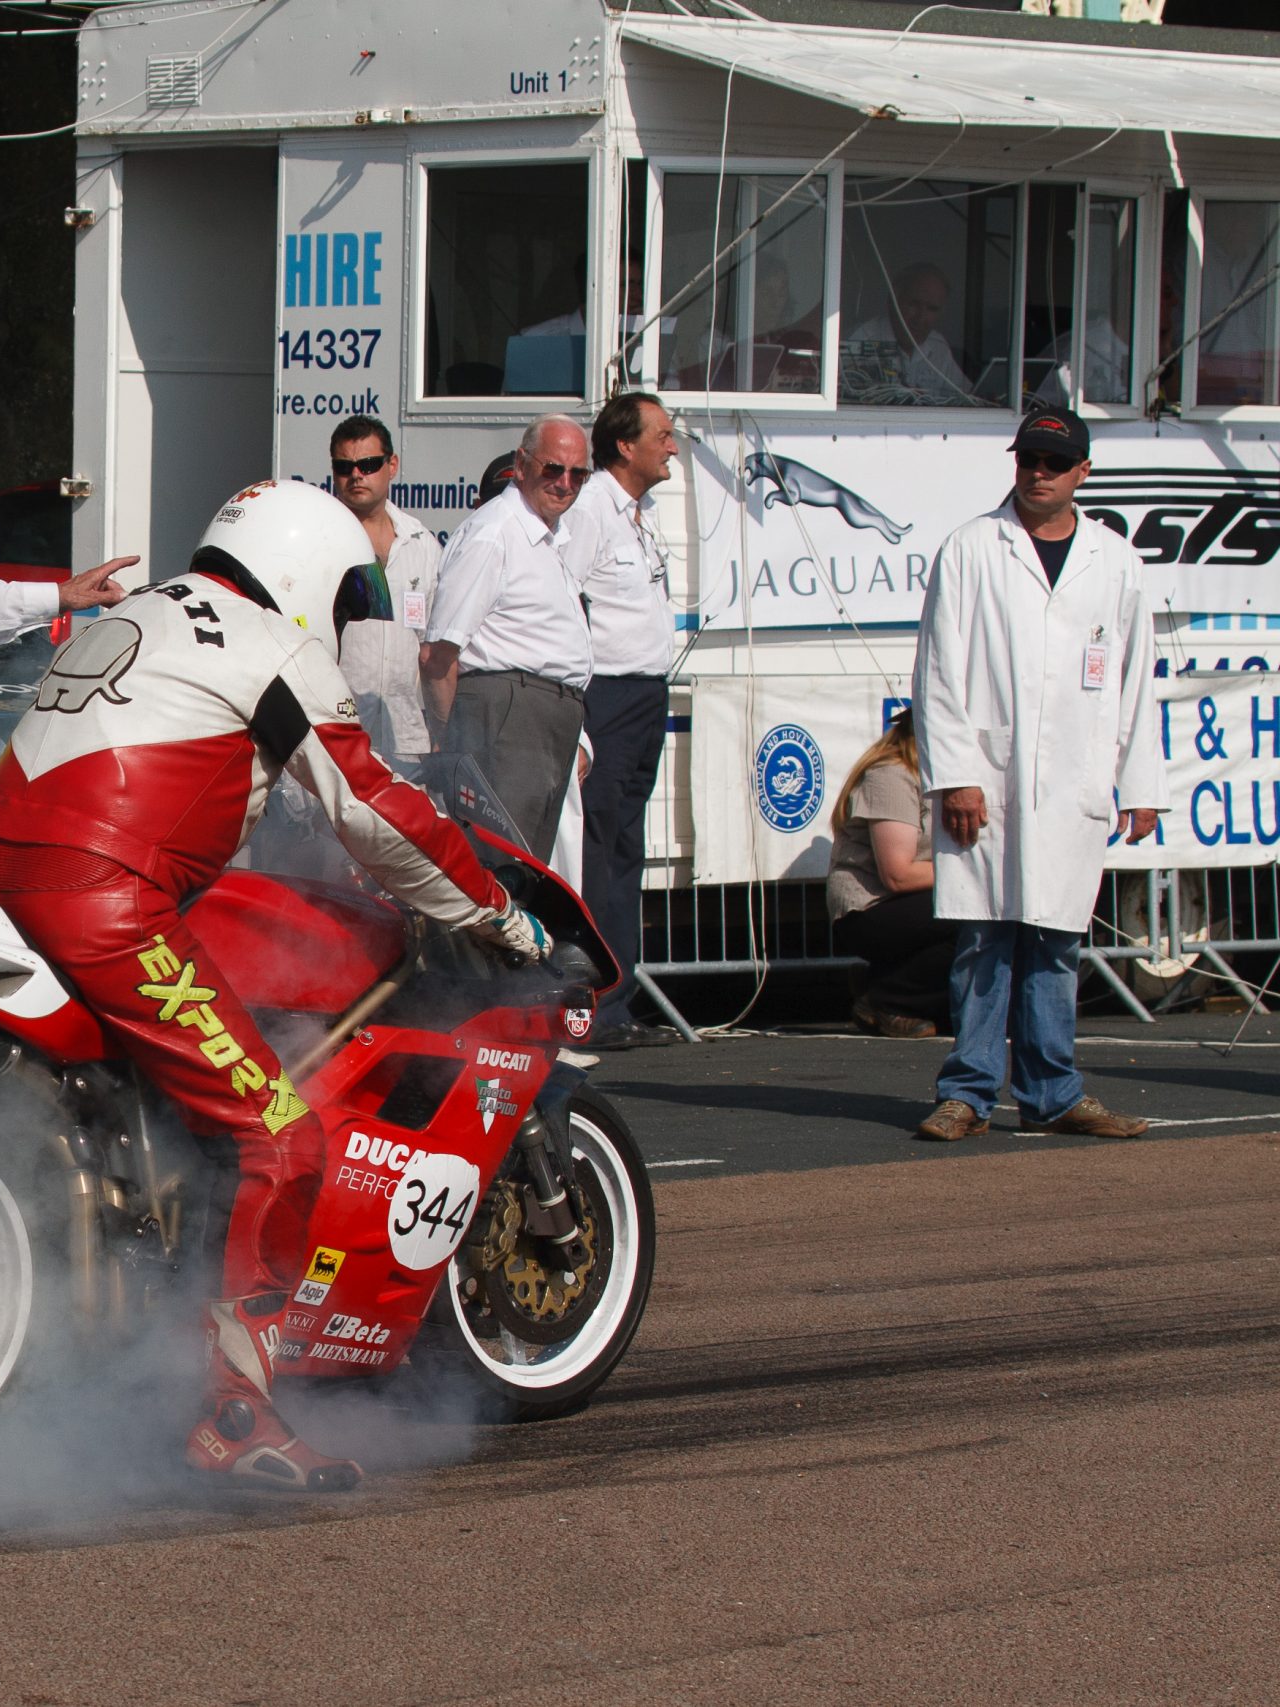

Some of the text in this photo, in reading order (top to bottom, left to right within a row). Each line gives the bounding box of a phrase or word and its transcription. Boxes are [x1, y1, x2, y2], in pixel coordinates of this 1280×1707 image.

[510, 70, 566, 94] Unit 1
[284, 232, 382, 307] HIRE
[727, 553, 928, 608] JAGUAR
[781, 730, 808, 746] HOVE
[1195, 695, 1228, 761] &
[762, 734, 780, 758] AND
[807, 745, 822, 791] MOTOR
[800, 795, 820, 823] CLUB
[476, 1047, 532, 1072] DUCATI
[476, 1097, 519, 1116] RAPIDO
[394, 1178, 475, 1244] 344
[300, 1283, 324, 1301] Agip
[338, 1316, 391, 1345] Beta
[307, 1342, 390, 1365] DIETSMANN
